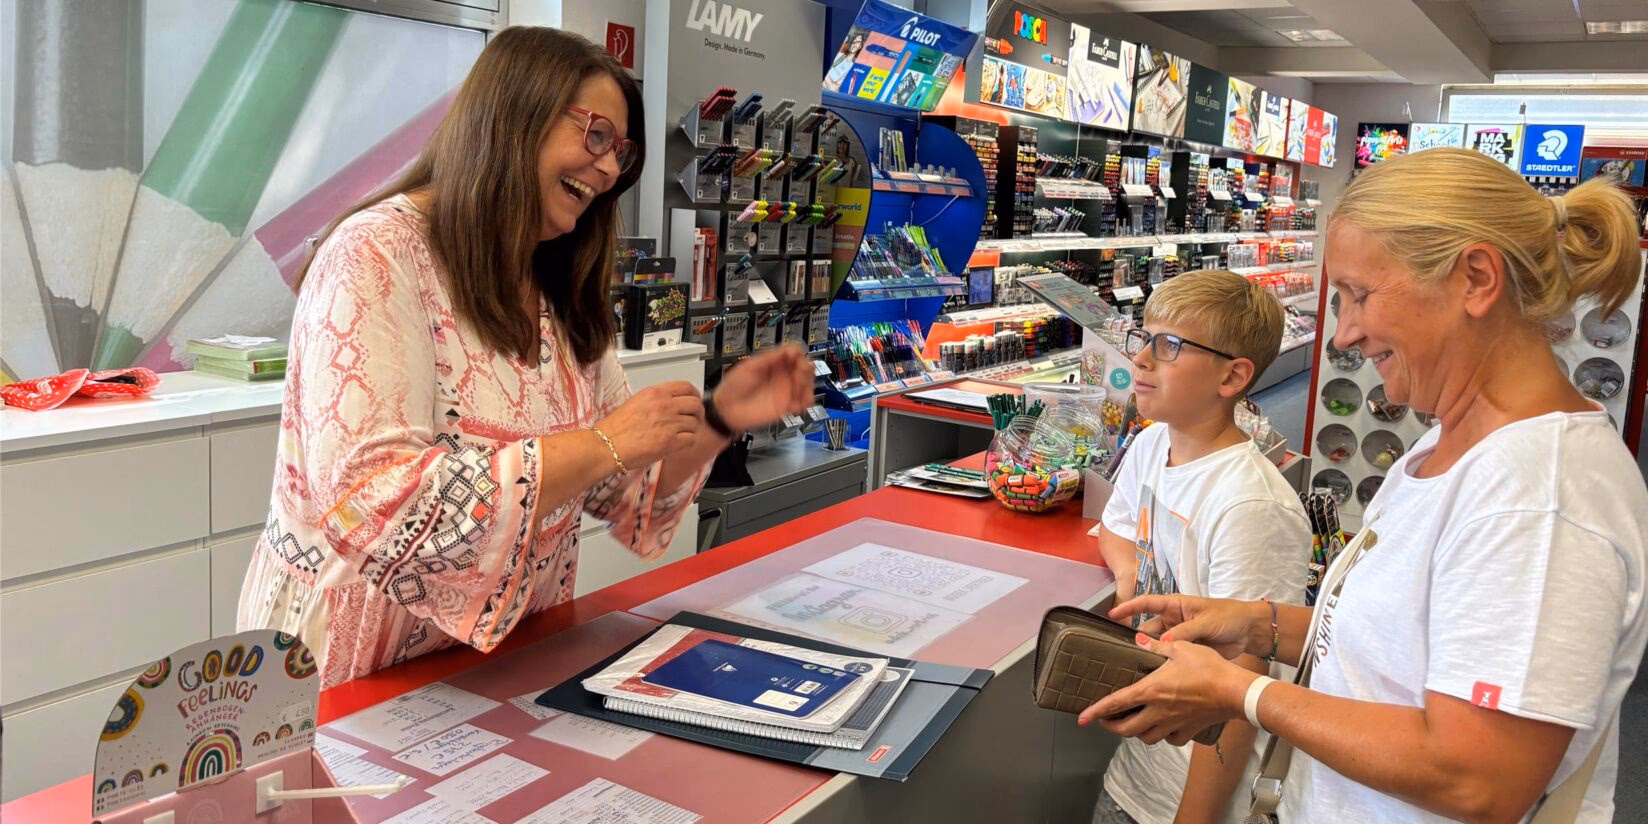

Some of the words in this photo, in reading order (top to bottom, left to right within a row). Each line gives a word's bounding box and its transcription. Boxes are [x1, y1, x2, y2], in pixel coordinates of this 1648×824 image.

[686, 0, 764, 42] LAMY
[1014, 10, 1047, 46] POSCA
[910, 27, 941, 47] PILOT
[723, 43, 738, 53] Made
[743, 48, 765, 61] Germany
[1526, 164, 1573, 172] STAEDTLER
[178, 644, 264, 692] GOOD
